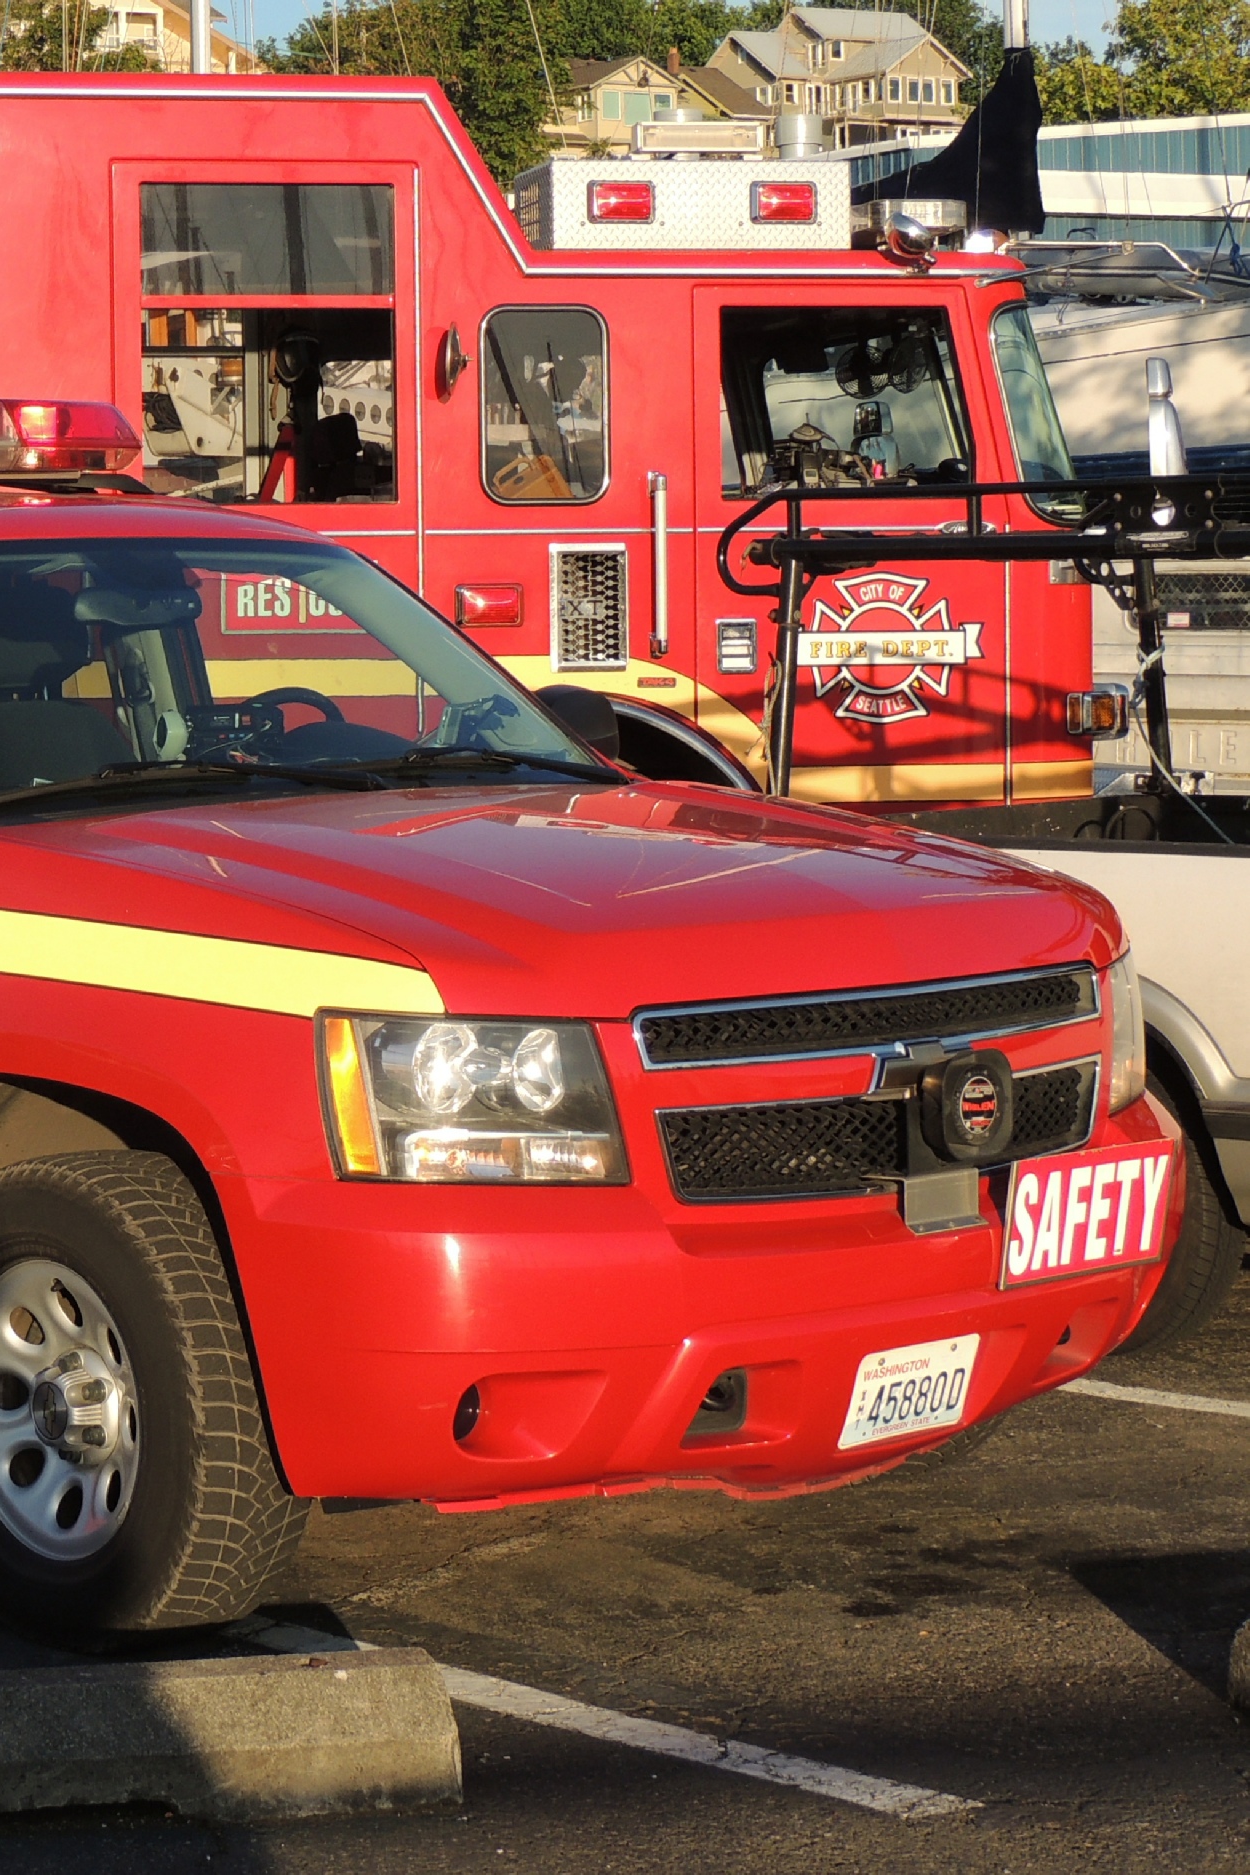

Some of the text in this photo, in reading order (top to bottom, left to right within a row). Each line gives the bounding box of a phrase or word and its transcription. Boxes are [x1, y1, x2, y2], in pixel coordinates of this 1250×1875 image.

[860, 583, 905, 601] CITY OF
[810, 640, 953, 658] FIRE DEPT.
[855, 695, 907, 714] SEATTLE
[1008, 1154, 1169, 1276] SAFETY
[863, 1357, 931, 1382] WASHINGTON
[866, 1367, 966, 1427] 45880D
[871, 1416, 931, 1436] EVERGREEN STATE
